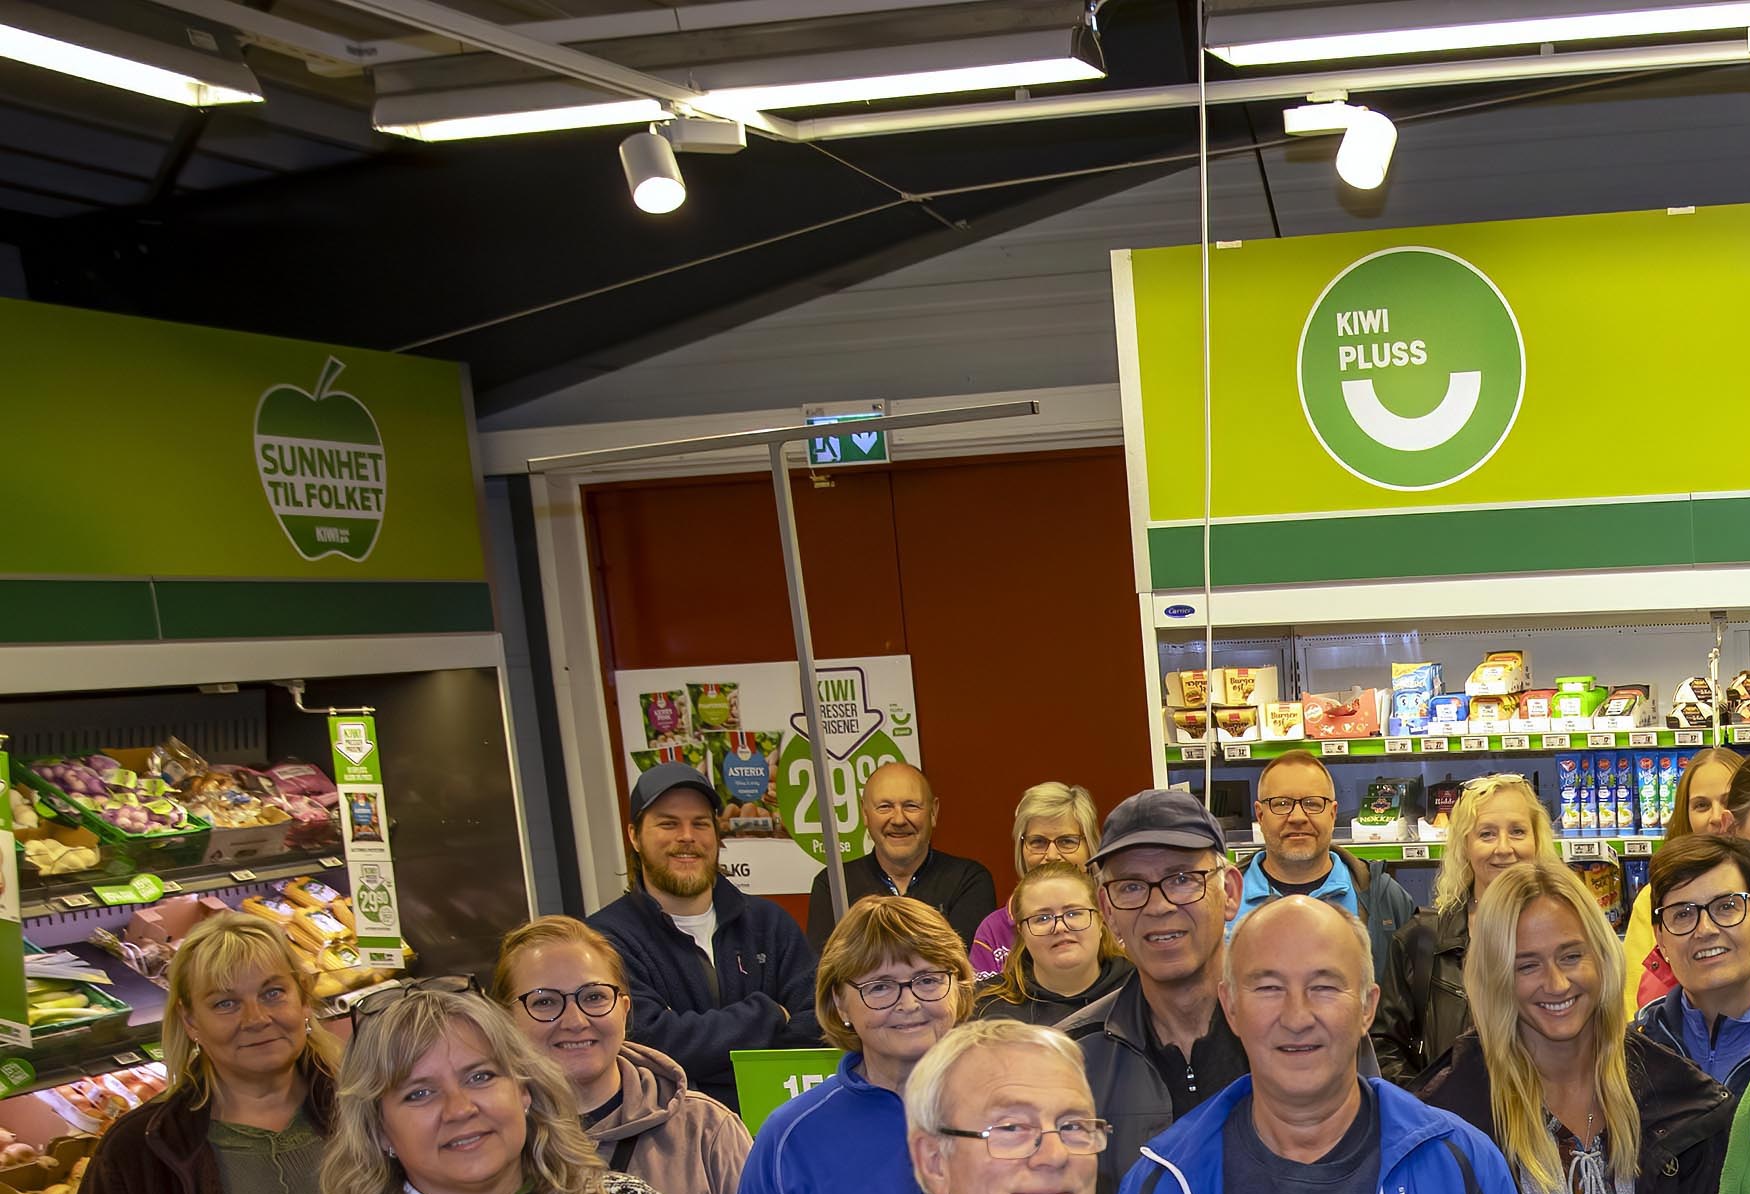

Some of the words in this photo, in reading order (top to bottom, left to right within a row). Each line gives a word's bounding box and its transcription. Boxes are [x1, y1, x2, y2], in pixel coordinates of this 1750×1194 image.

[1337, 308, 1390, 337] KIWI
[1339, 340, 1428, 371] PLUSS
[261, 443, 383, 483] SUNNHET
[268, 481, 304, 508] TIL
[304, 482, 384, 513] FOLKET
[728, 766, 765, 777] ASTERIX
